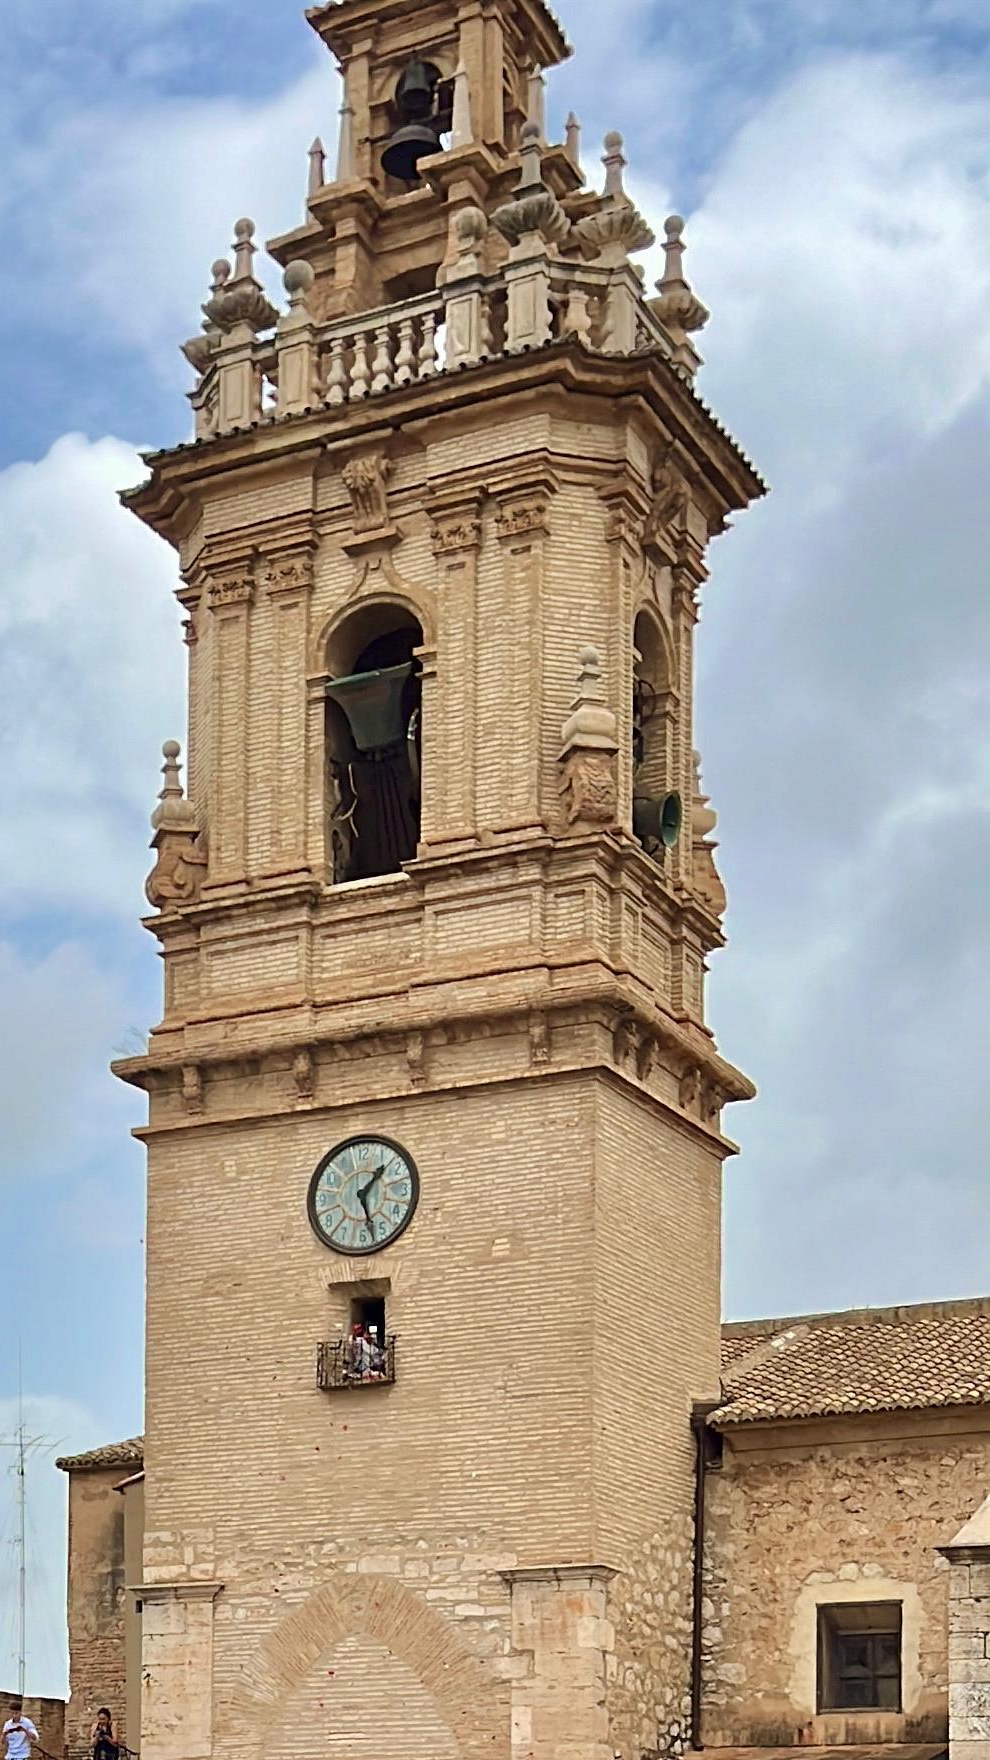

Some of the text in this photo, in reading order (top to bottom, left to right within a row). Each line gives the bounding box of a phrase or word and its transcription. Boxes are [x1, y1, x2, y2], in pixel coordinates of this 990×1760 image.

[359, 1147, 370, 1161] 12
[394, 1162, 402, 1176] 2
[401, 1182, 408, 1197] 3
[319, 1194, 327, 1207] 9
[392, 1204, 400, 1218] 4
[325, 1214, 333, 1229] 8
[378, 1221, 387, 1236] 5
[340, 1227, 347, 1241] 7
[359, 1229, 367, 1243] 6
